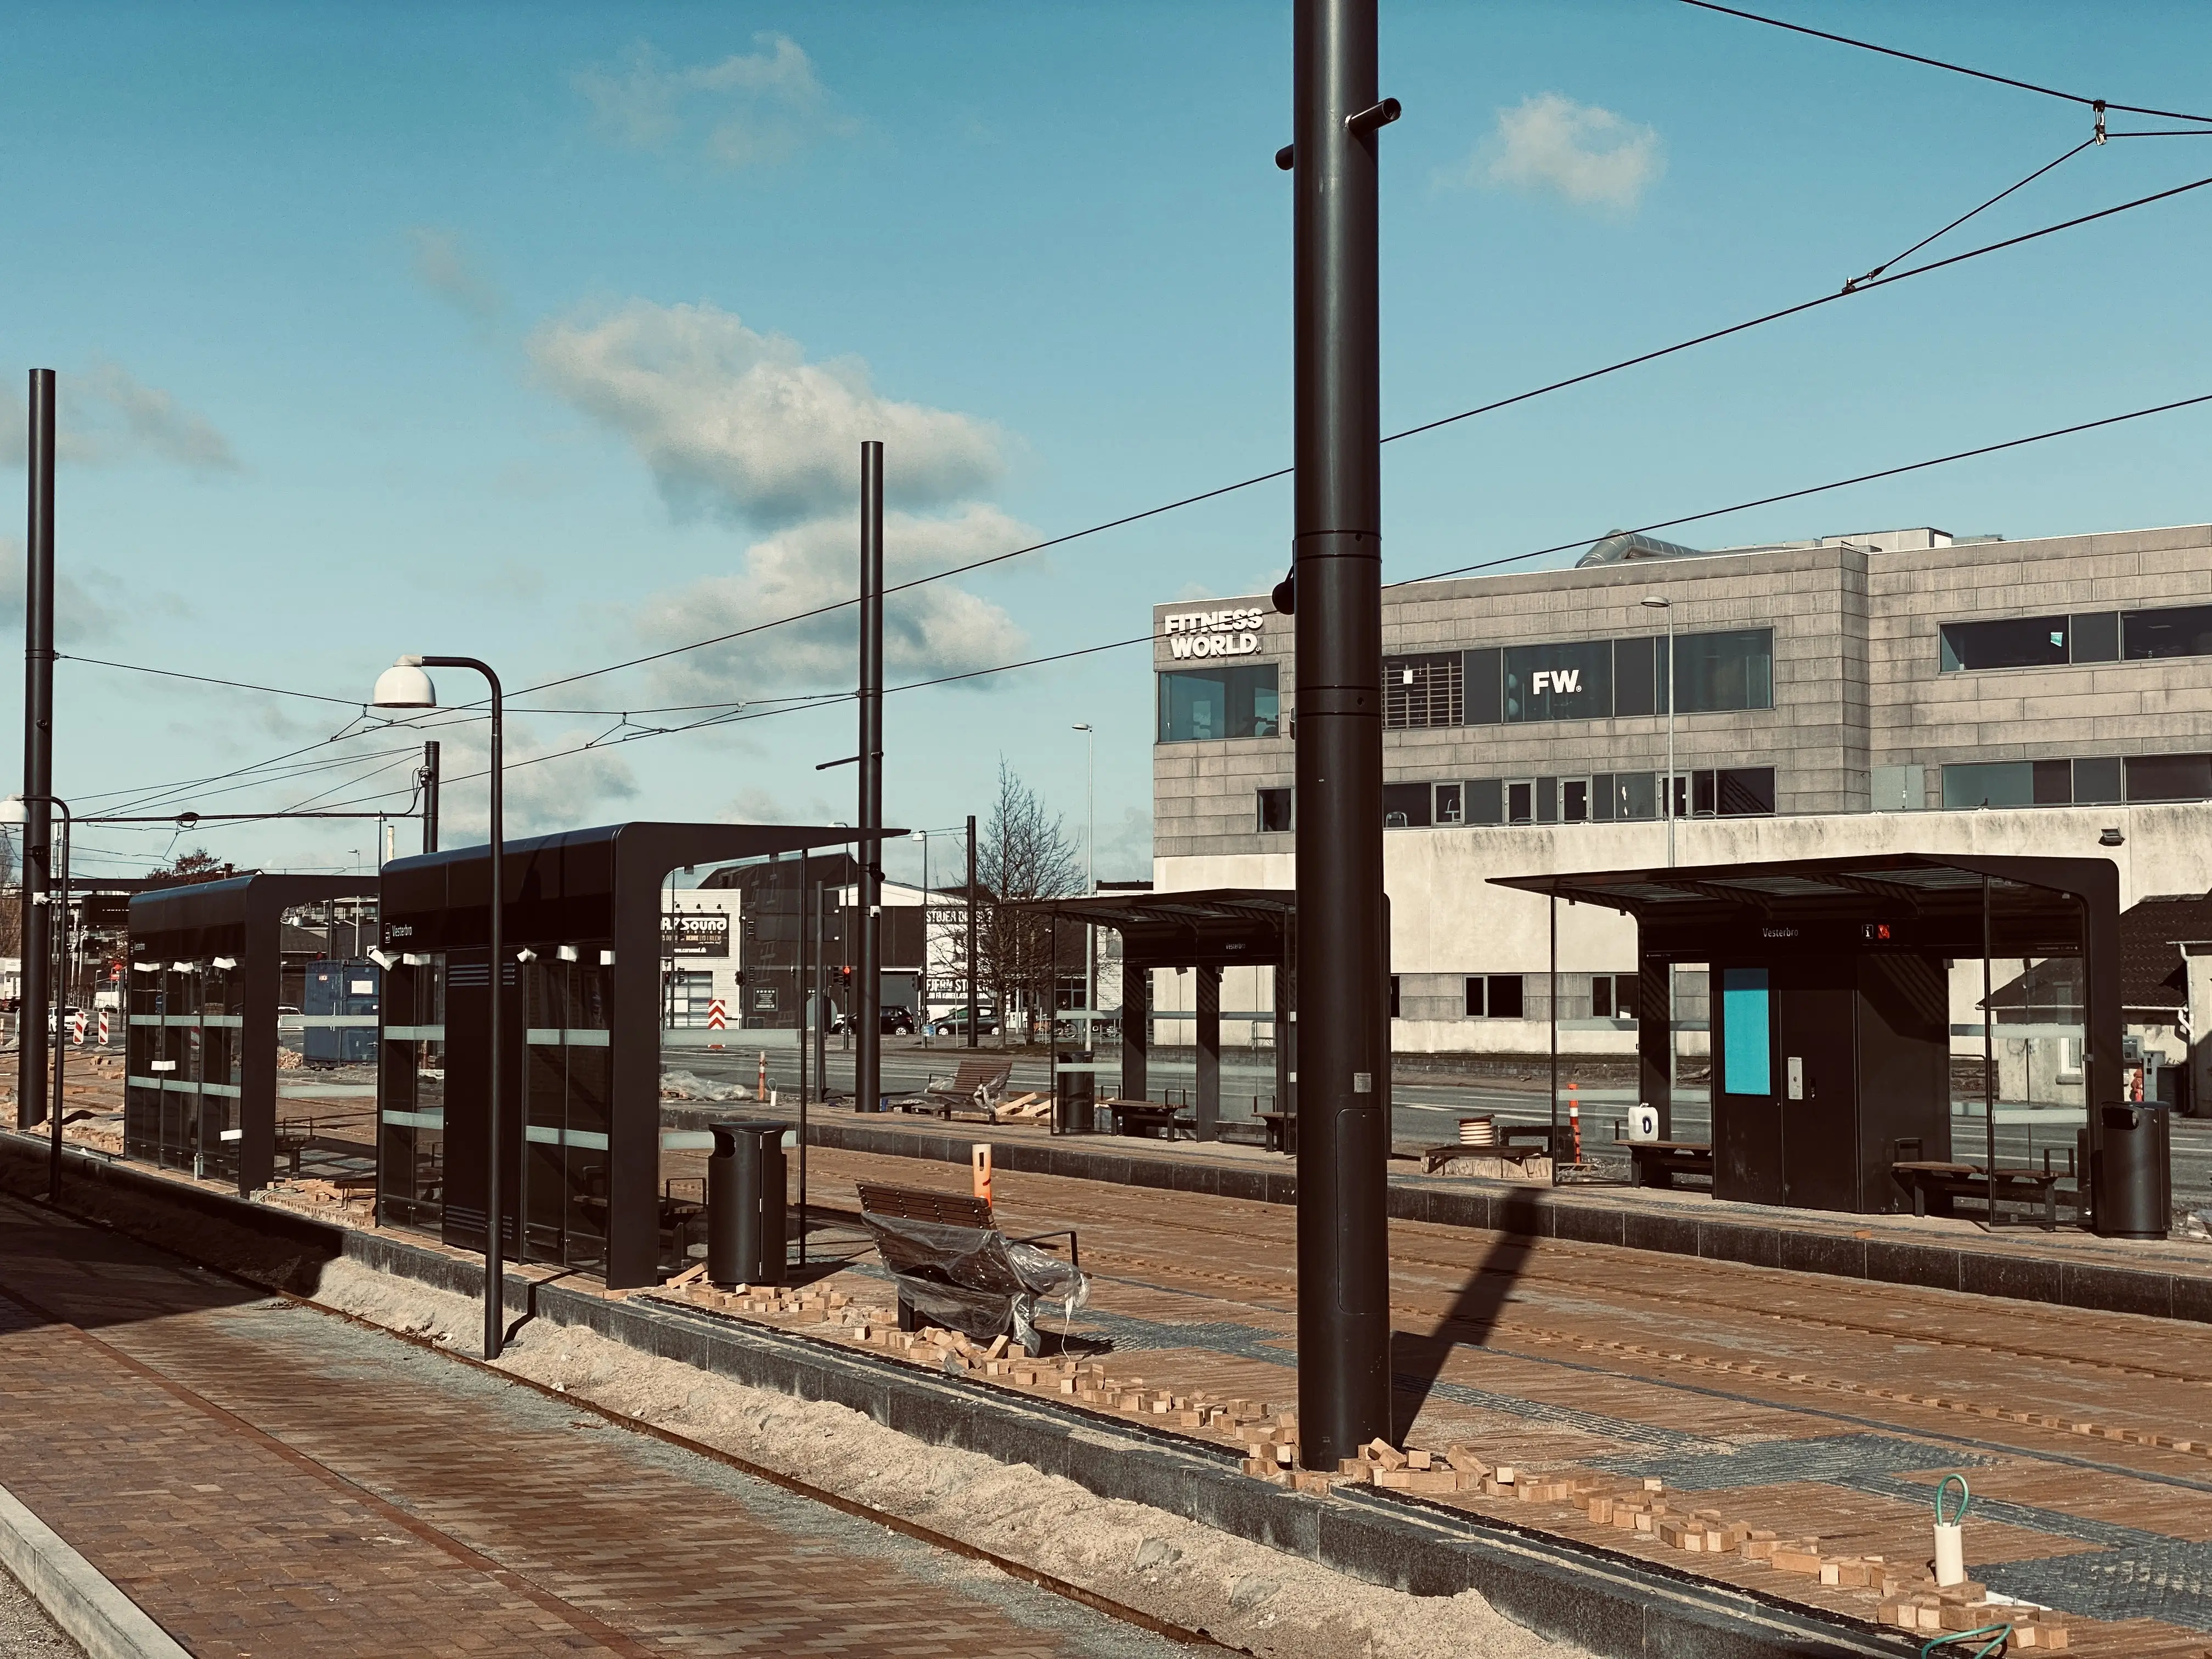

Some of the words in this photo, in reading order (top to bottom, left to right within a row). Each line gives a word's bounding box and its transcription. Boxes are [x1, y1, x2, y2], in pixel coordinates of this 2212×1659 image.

[1165, 608, 1263, 635] FITNESS
[392, 924, 413, 937] Vesterbro
[680, 917, 727, 931] Sound
[1762, 927, 1799, 938] Vesterbro
